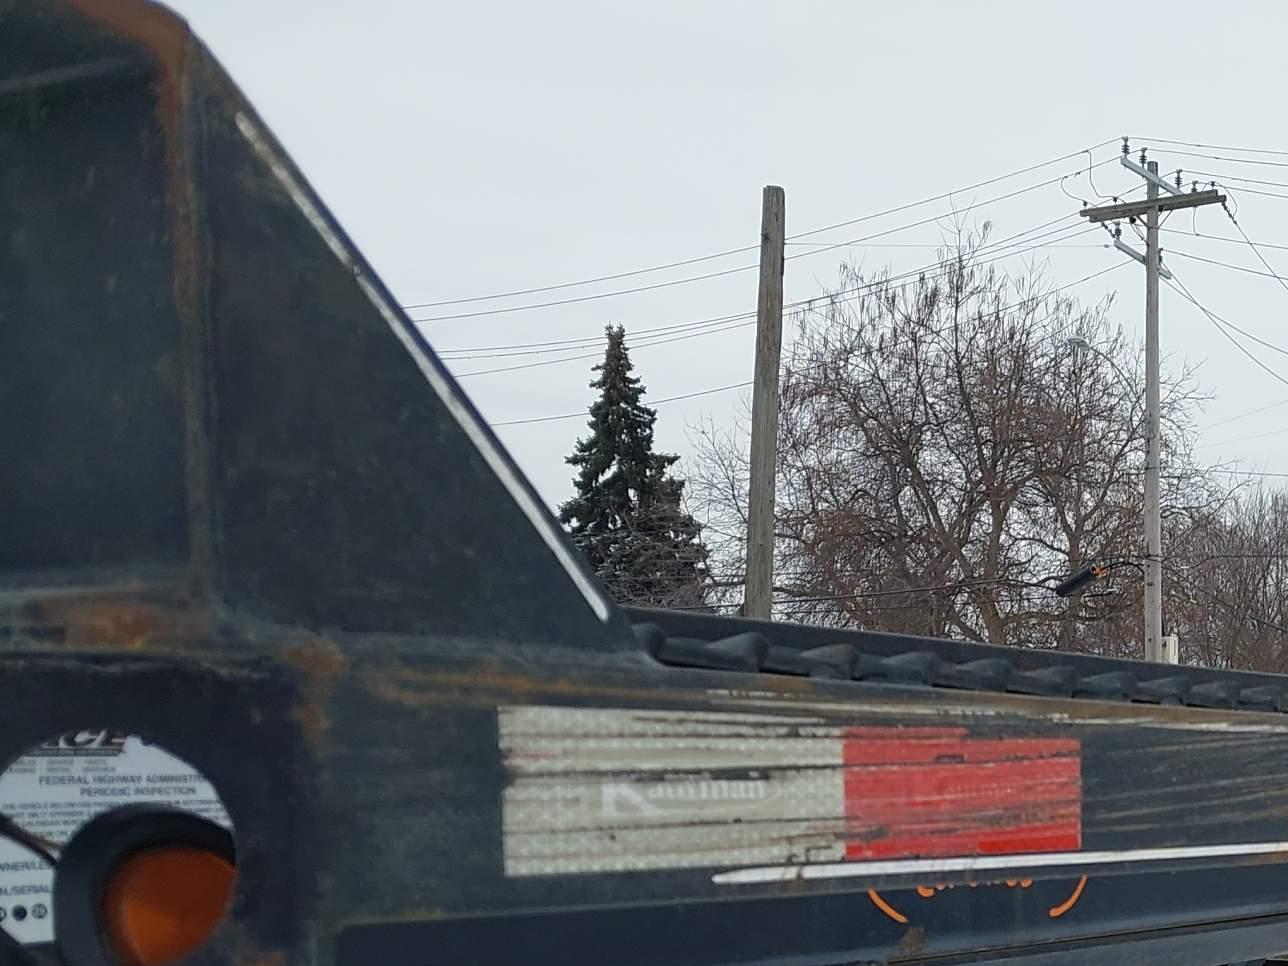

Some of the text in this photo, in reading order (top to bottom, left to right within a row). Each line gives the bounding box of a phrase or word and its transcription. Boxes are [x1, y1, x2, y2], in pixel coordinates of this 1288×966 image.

[39, 775, 90, 785] FEDERAL
[93, 775, 142, 784] HIGHWAY
[80, 786, 196, 797] PERIODIC INSPECTION
